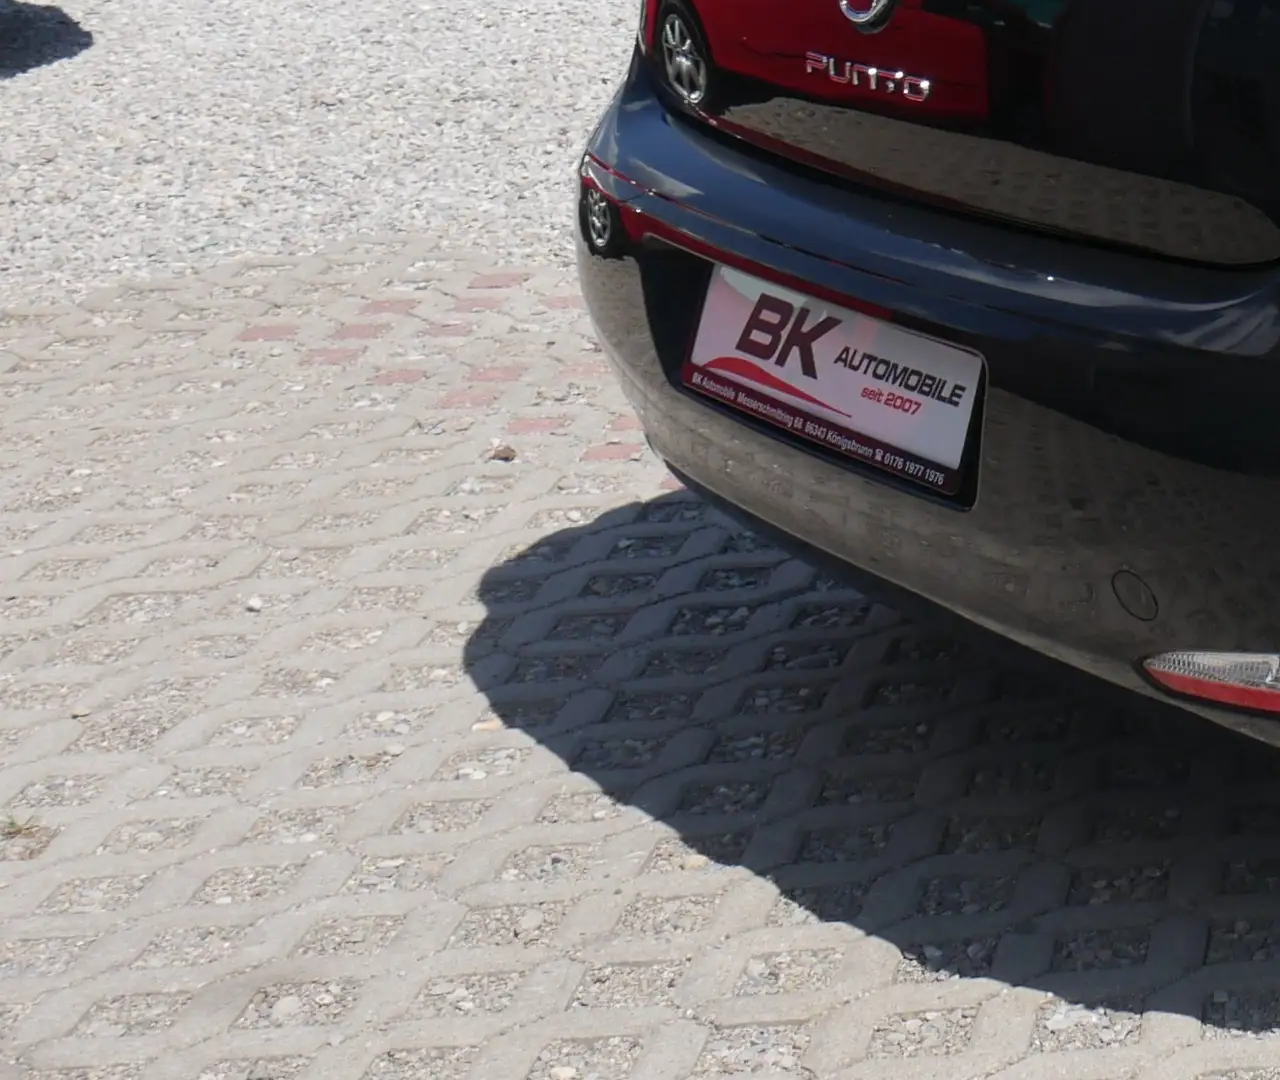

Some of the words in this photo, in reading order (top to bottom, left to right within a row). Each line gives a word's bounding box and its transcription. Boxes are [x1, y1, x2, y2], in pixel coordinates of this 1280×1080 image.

[805, 51, 930, 102] PUNTO
[735, 292, 842, 380] BK
[833, 345, 967, 408] AUTOMOBILE
[692, 371, 703, 385] BK
[702, 377, 736, 400] Automobile
[826, 430, 874, 459] Königsbrunn
[884, 452, 904, 470] 0176
[905, 461, 924, 477] 1977
[925, 468, 945, 485] 1976
[860, 387, 884, 406] seit
[884, 394, 923, 416] 2007
